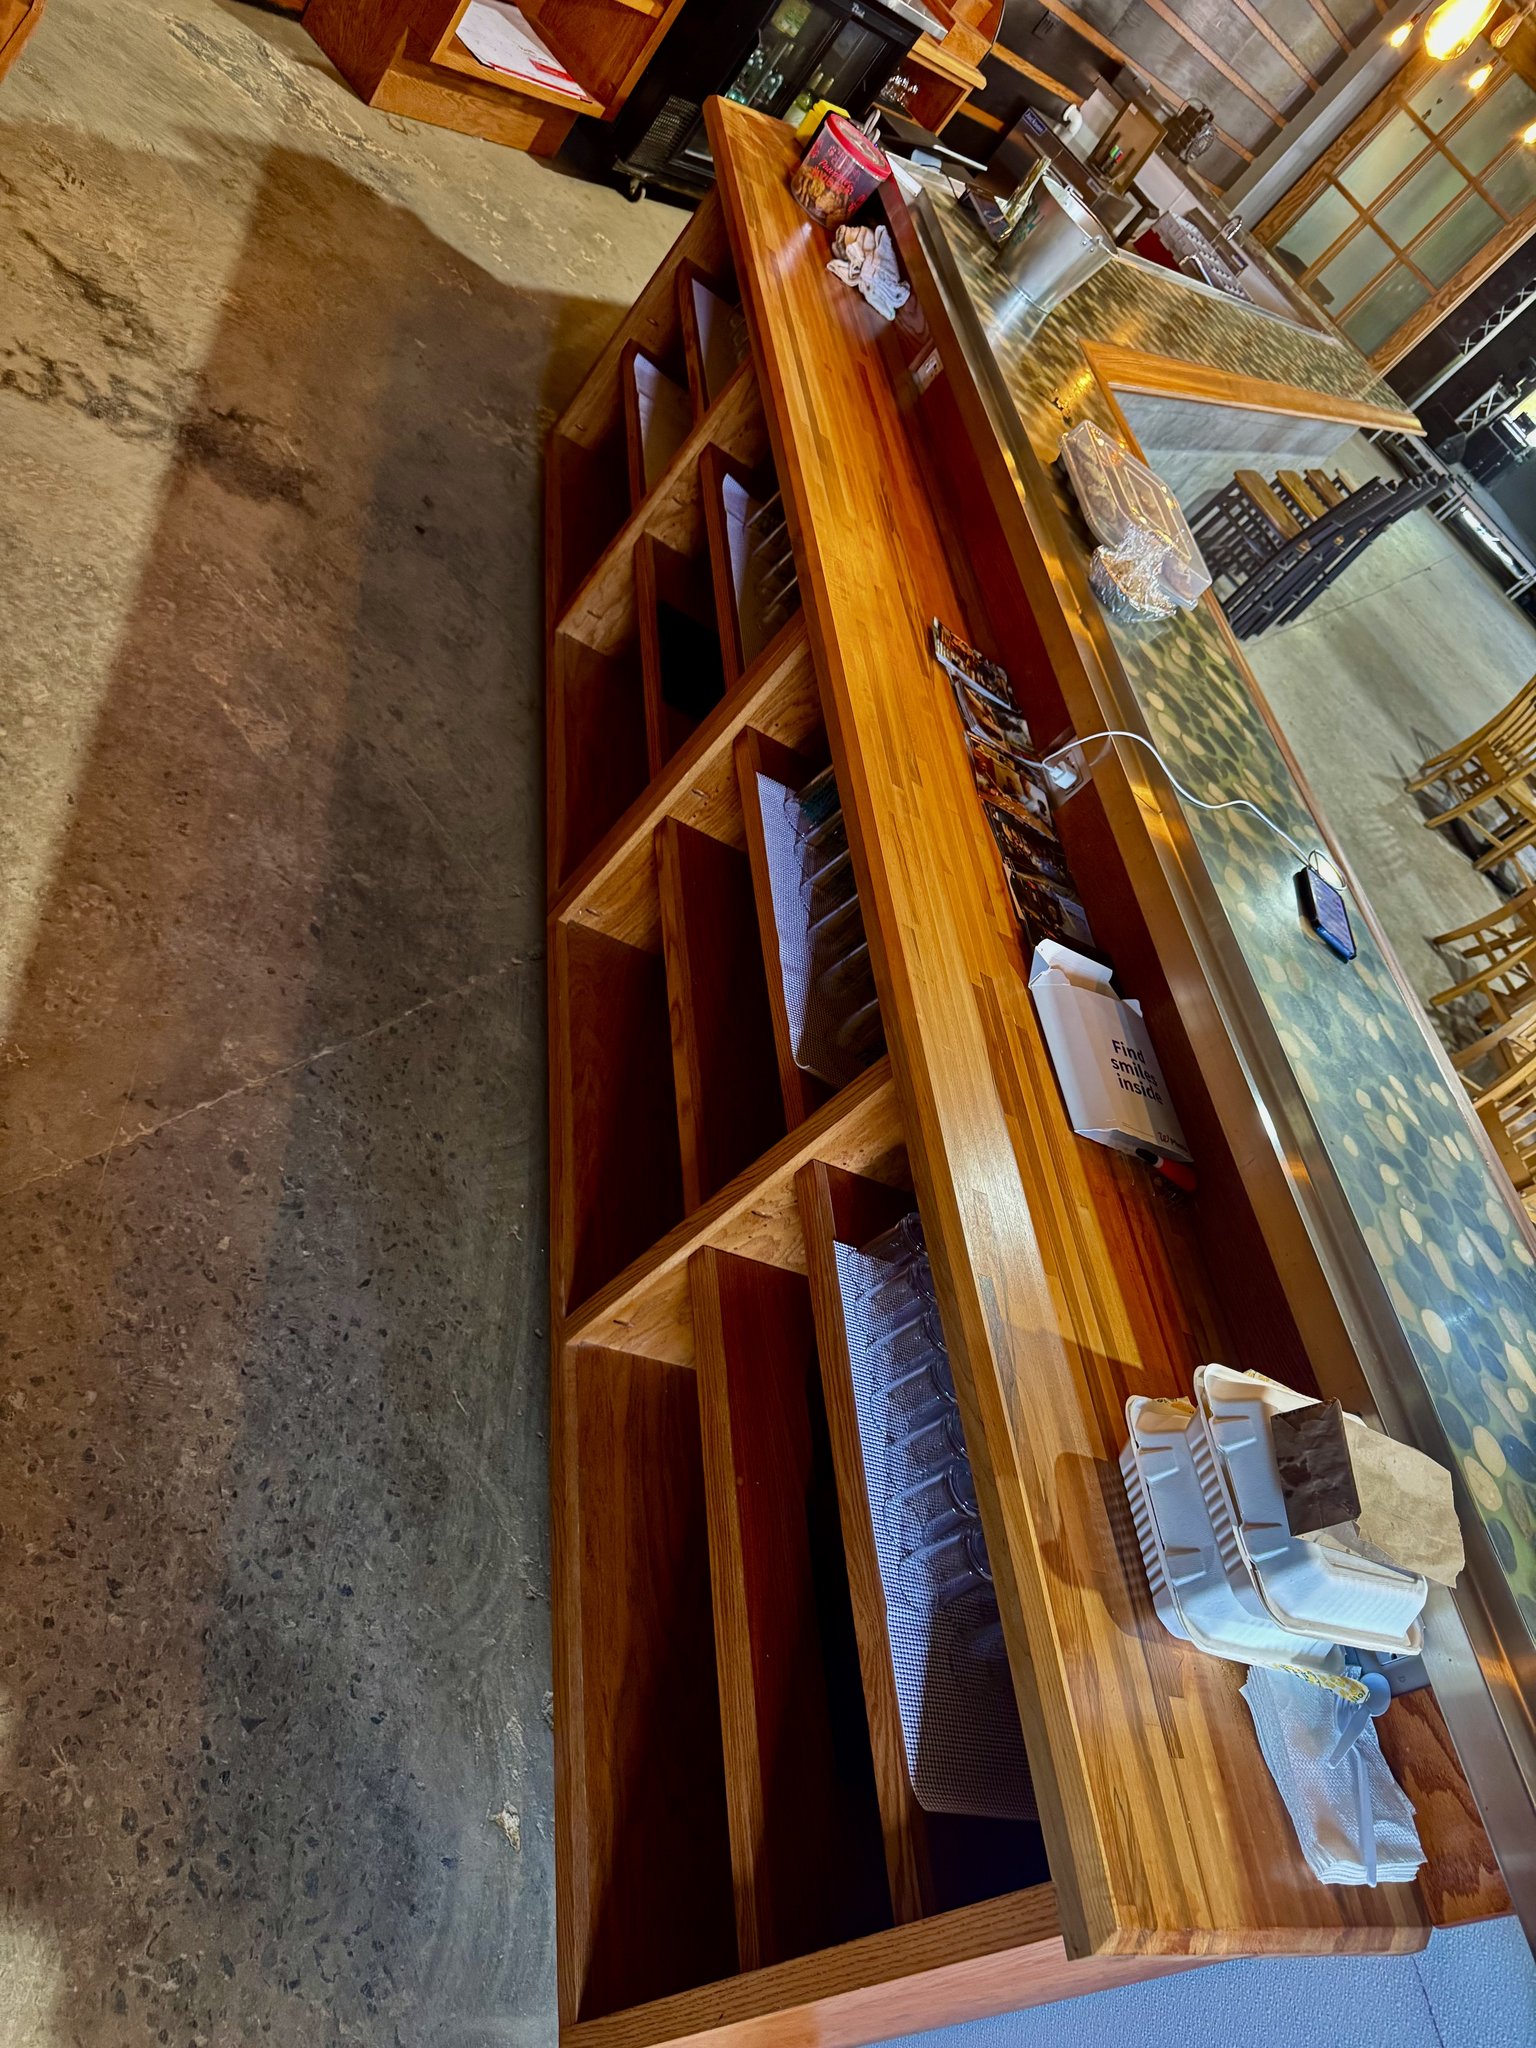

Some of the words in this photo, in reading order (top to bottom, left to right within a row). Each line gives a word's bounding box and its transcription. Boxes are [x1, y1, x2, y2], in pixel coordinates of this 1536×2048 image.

[1111, 1039, 1146, 1065] Find
[1110, 1058, 1158, 1087] smiles
[1116, 1072, 1163, 1105] inside
